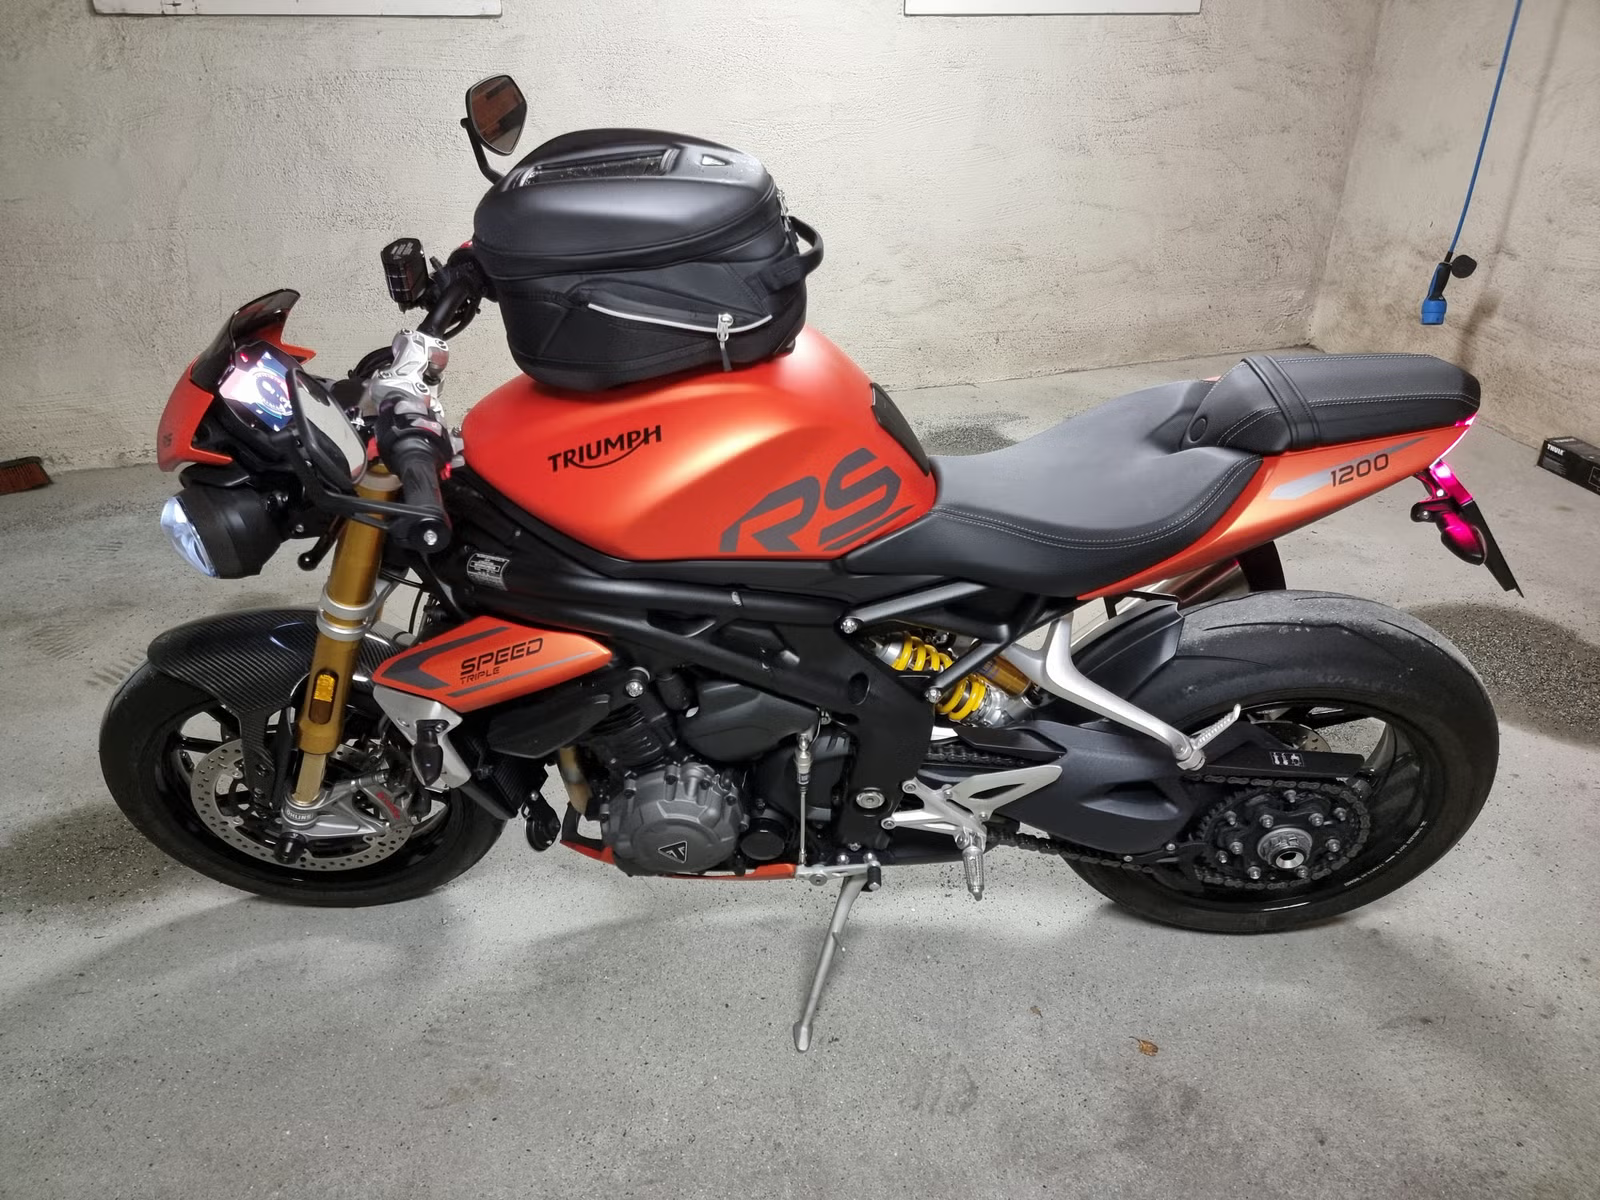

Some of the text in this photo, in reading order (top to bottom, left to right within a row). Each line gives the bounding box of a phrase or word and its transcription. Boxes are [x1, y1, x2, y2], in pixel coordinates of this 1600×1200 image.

[547, 424, 662, 473] TRIUMPH
[1331, 453, 1389, 488] 1200
[719, 447, 903, 553] RS
[460, 637, 544, 676] SPEED
[460, 666, 501, 685] TRIPLE
